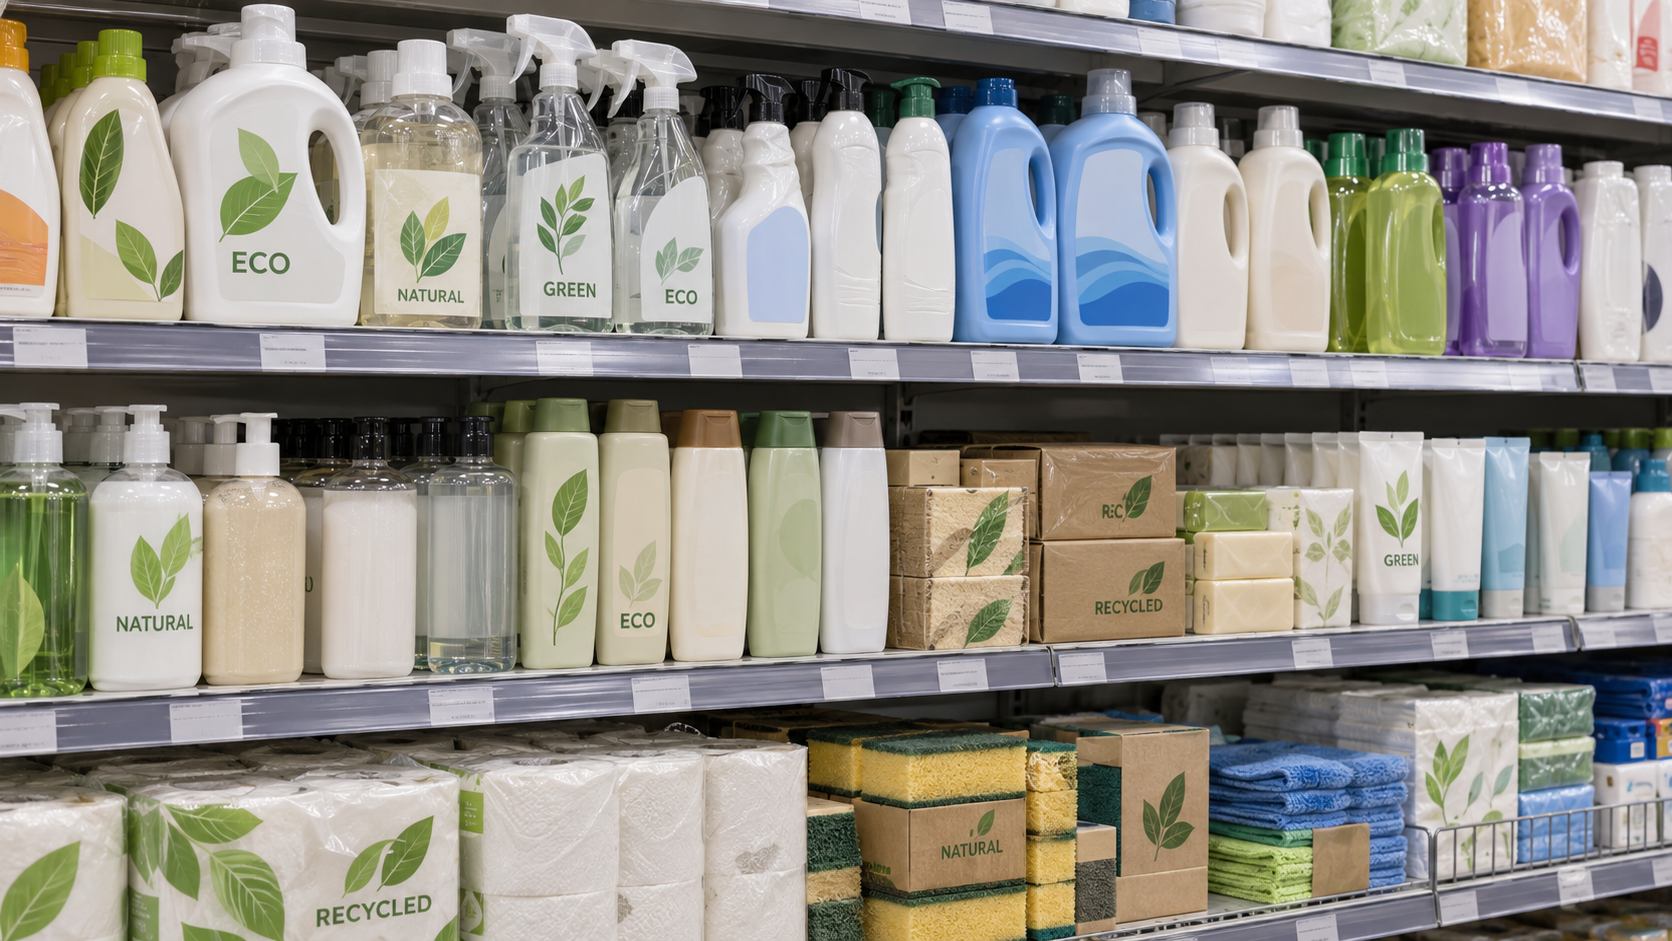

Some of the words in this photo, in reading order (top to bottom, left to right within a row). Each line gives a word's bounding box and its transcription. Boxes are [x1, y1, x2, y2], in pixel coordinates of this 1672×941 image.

[232, 250, 291, 275] ECO
[397, 288, 465, 304] NATURAL
[543, 280, 597, 298] GREEN
[665, 288, 698, 306] ECO
[1383, 553, 1419, 567] GREEN
[1095, 598, 1163, 616] RECYCLED
[116, 613, 194, 633] NATURAL
[620, 611, 656, 630] ECO
[941, 839, 1003, 861] NATURAL
[316, 894, 432, 928] RECYCLED
